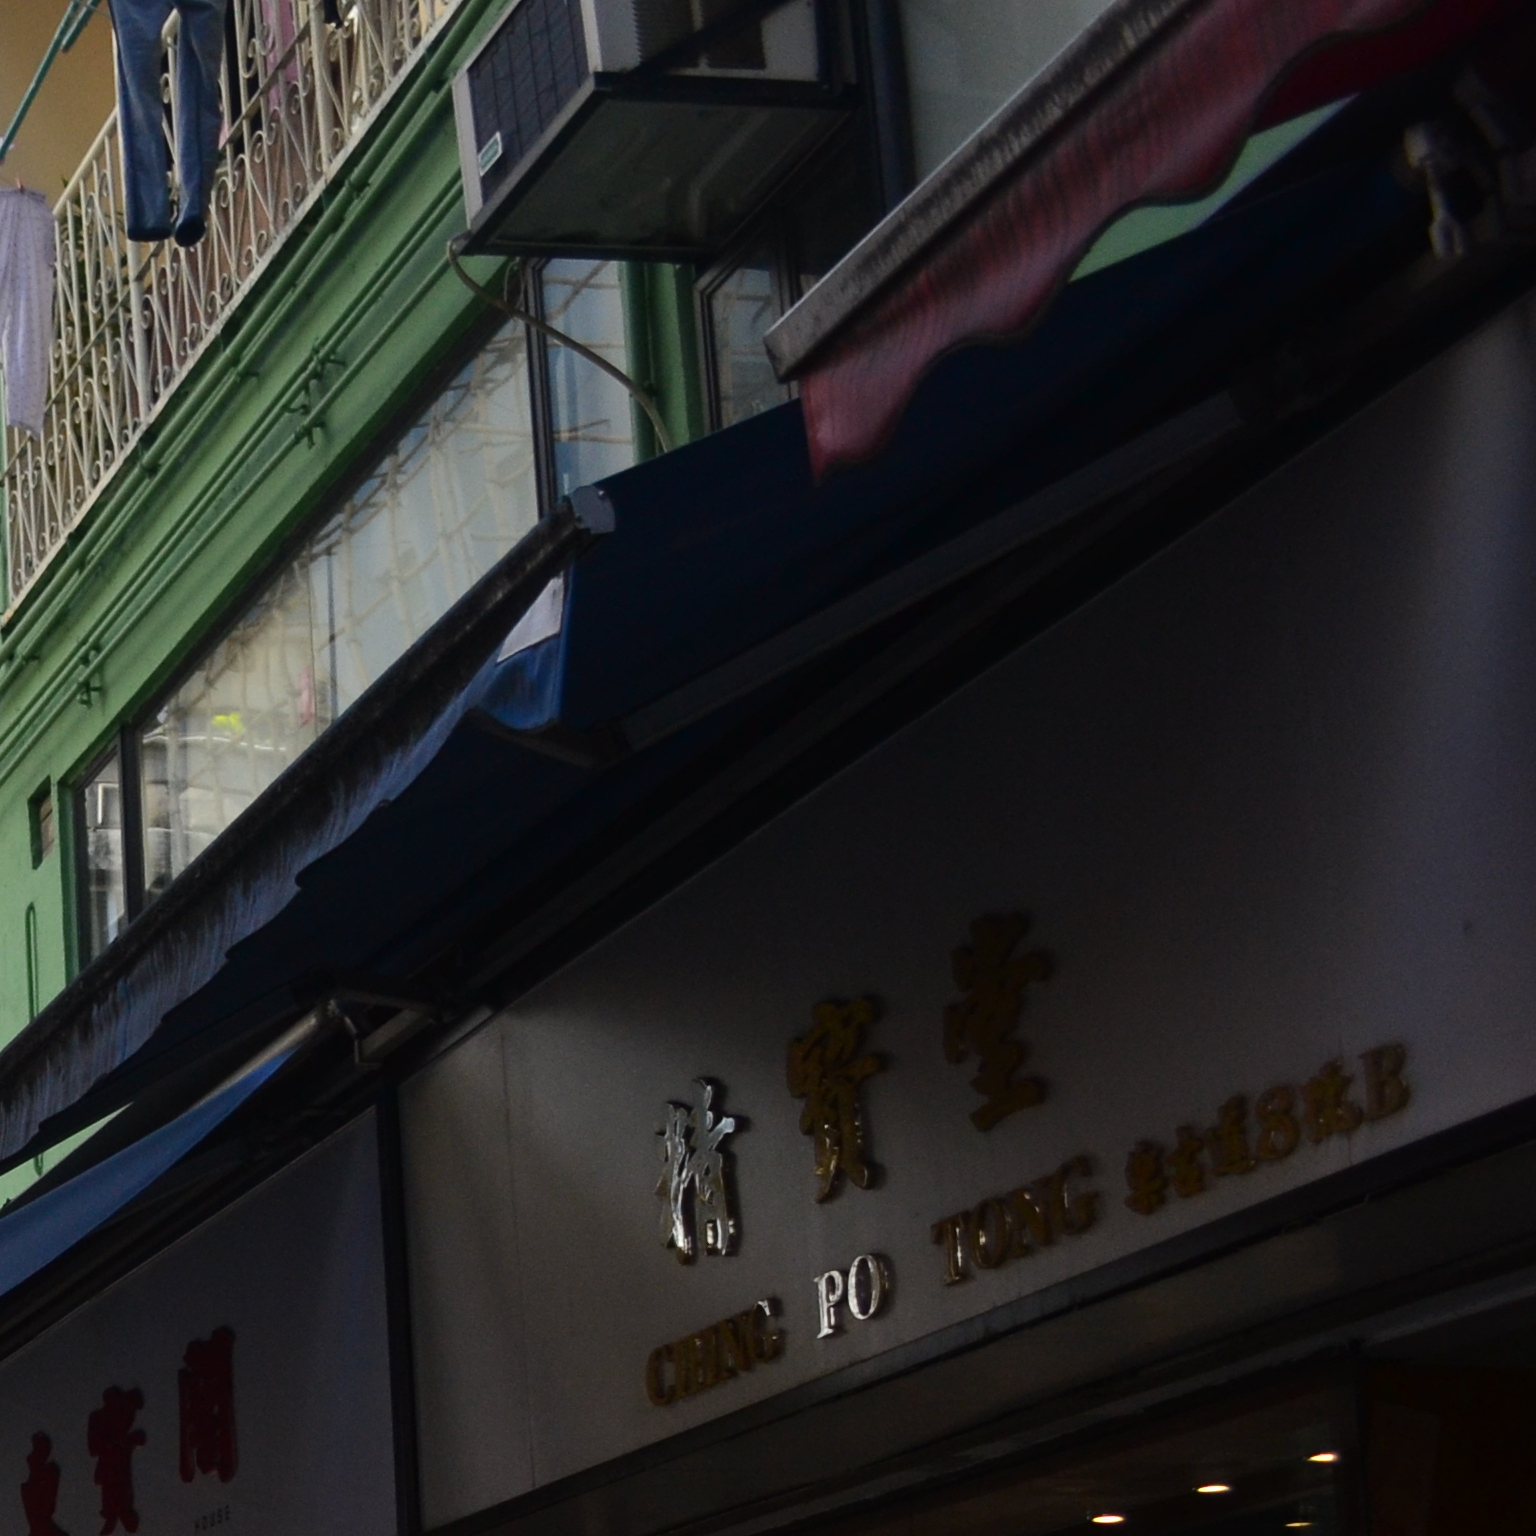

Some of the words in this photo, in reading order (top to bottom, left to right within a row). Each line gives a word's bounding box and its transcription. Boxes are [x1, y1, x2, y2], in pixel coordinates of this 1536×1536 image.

[645, 1295, 784, 1408] CHING
[813, 1252, 889, 1340] PO
[930, 1155, 1099, 1286] TONG
